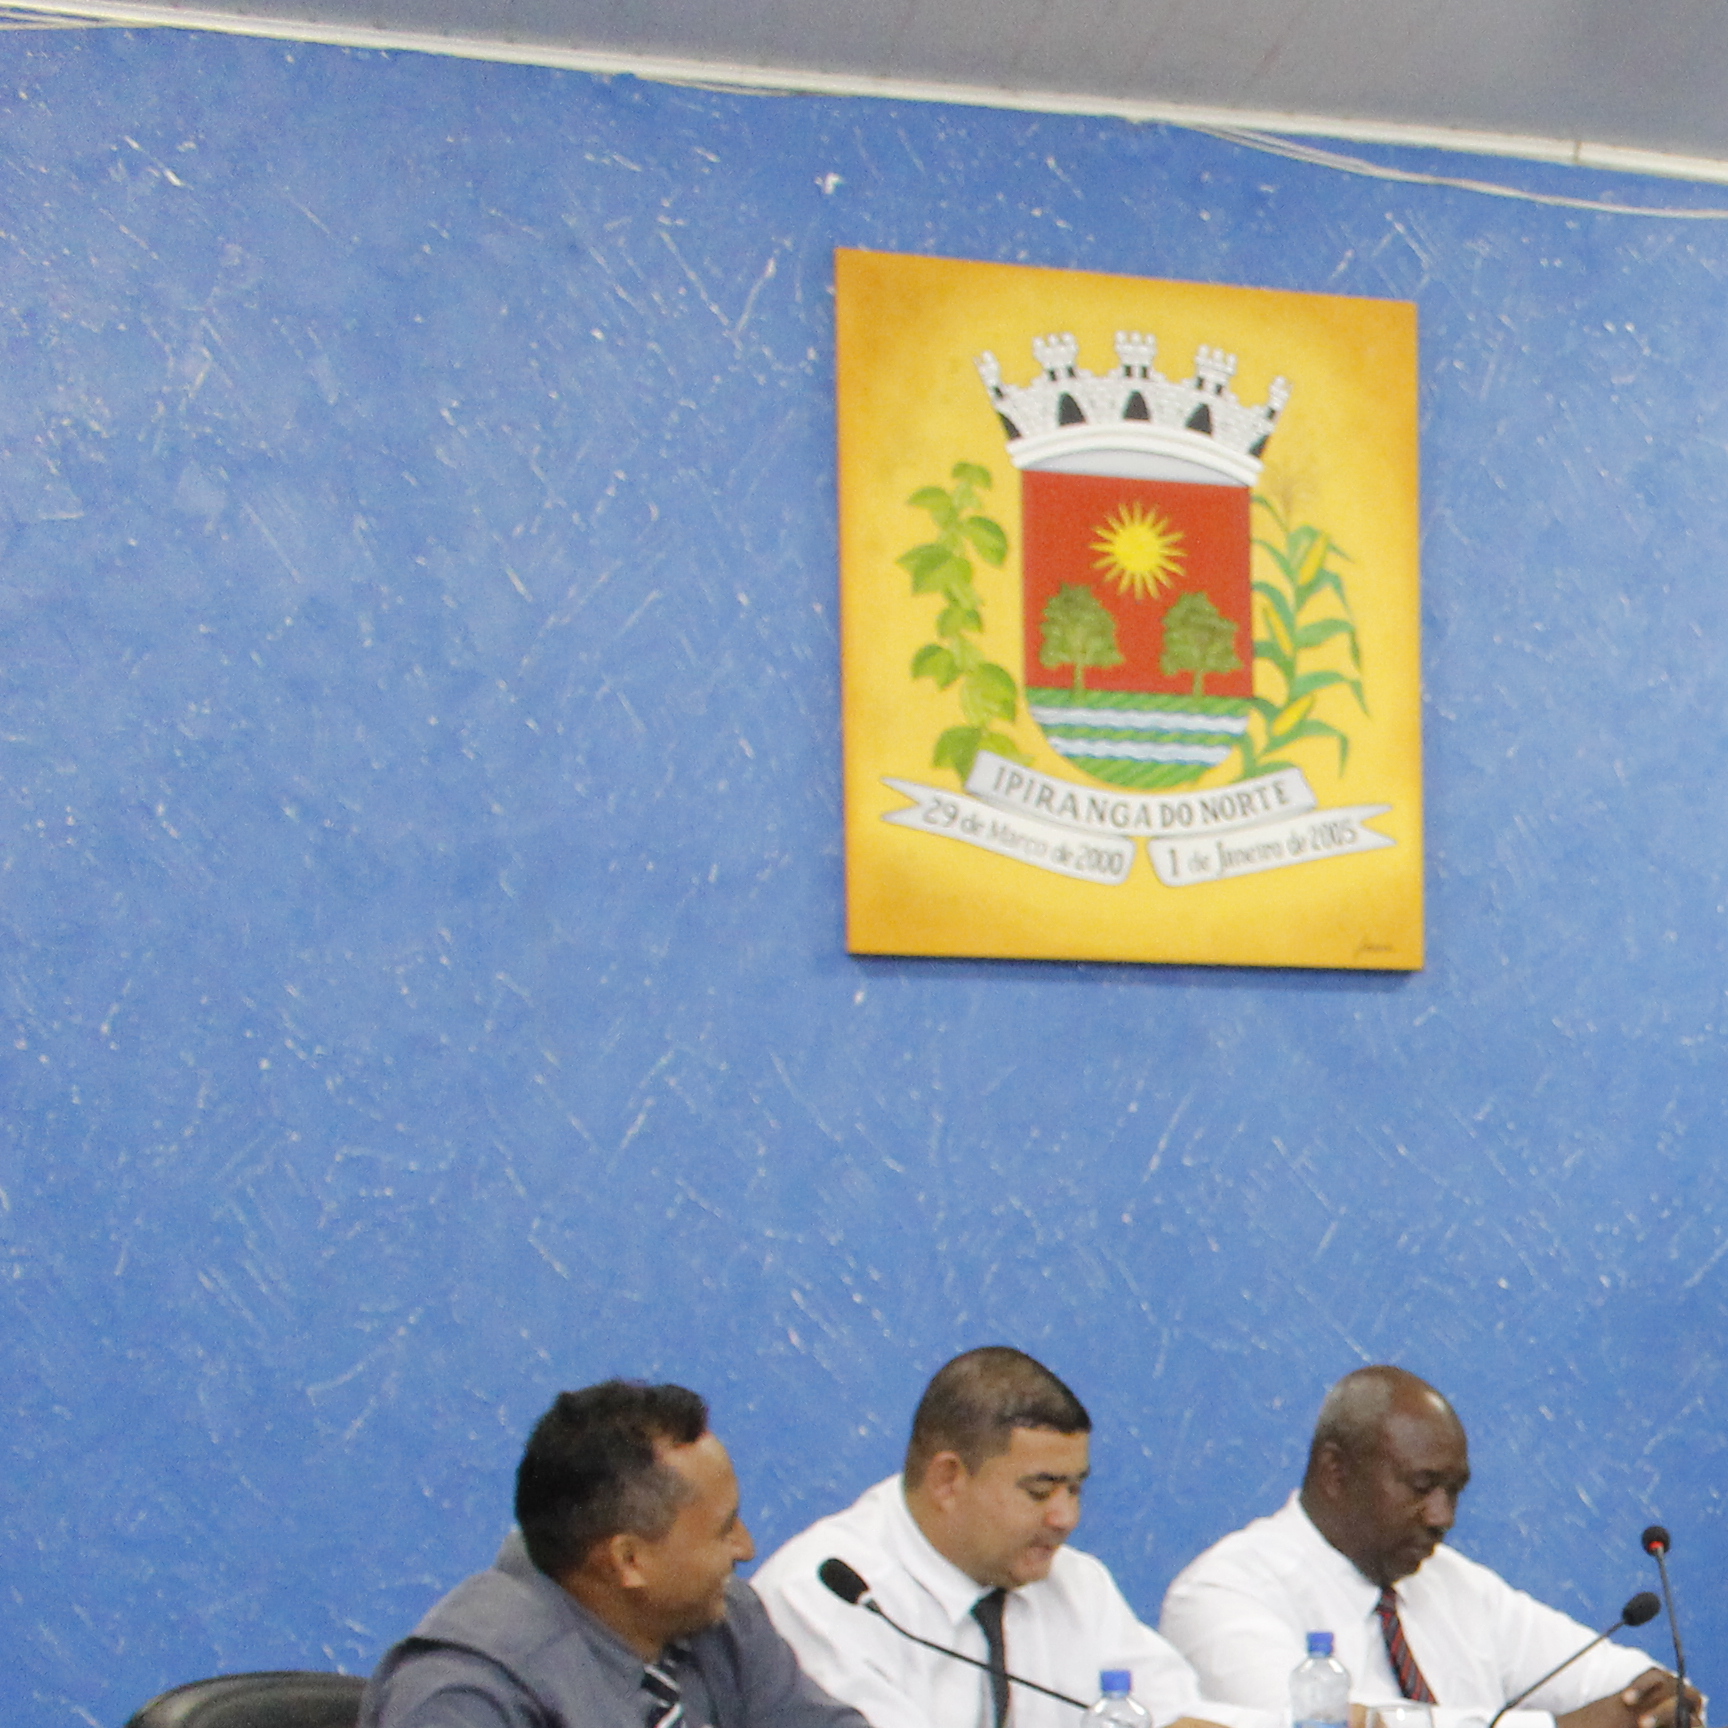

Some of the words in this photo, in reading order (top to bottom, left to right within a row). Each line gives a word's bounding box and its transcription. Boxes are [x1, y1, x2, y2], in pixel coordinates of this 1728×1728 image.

[992, 766, 1152, 829] IPIRANGA
[1160, 802, 1194, 829] DO
[1200, 780, 1291, 825] NORTE
[922, 796, 960, 829] 29
[961, 812, 985, 836] de
[1053, 842, 1074, 864] de
[1074, 842, 1125, 876] 2000
[1168, 847, 1179, 877] 1
[1308, 818, 1358, 852] 2005
